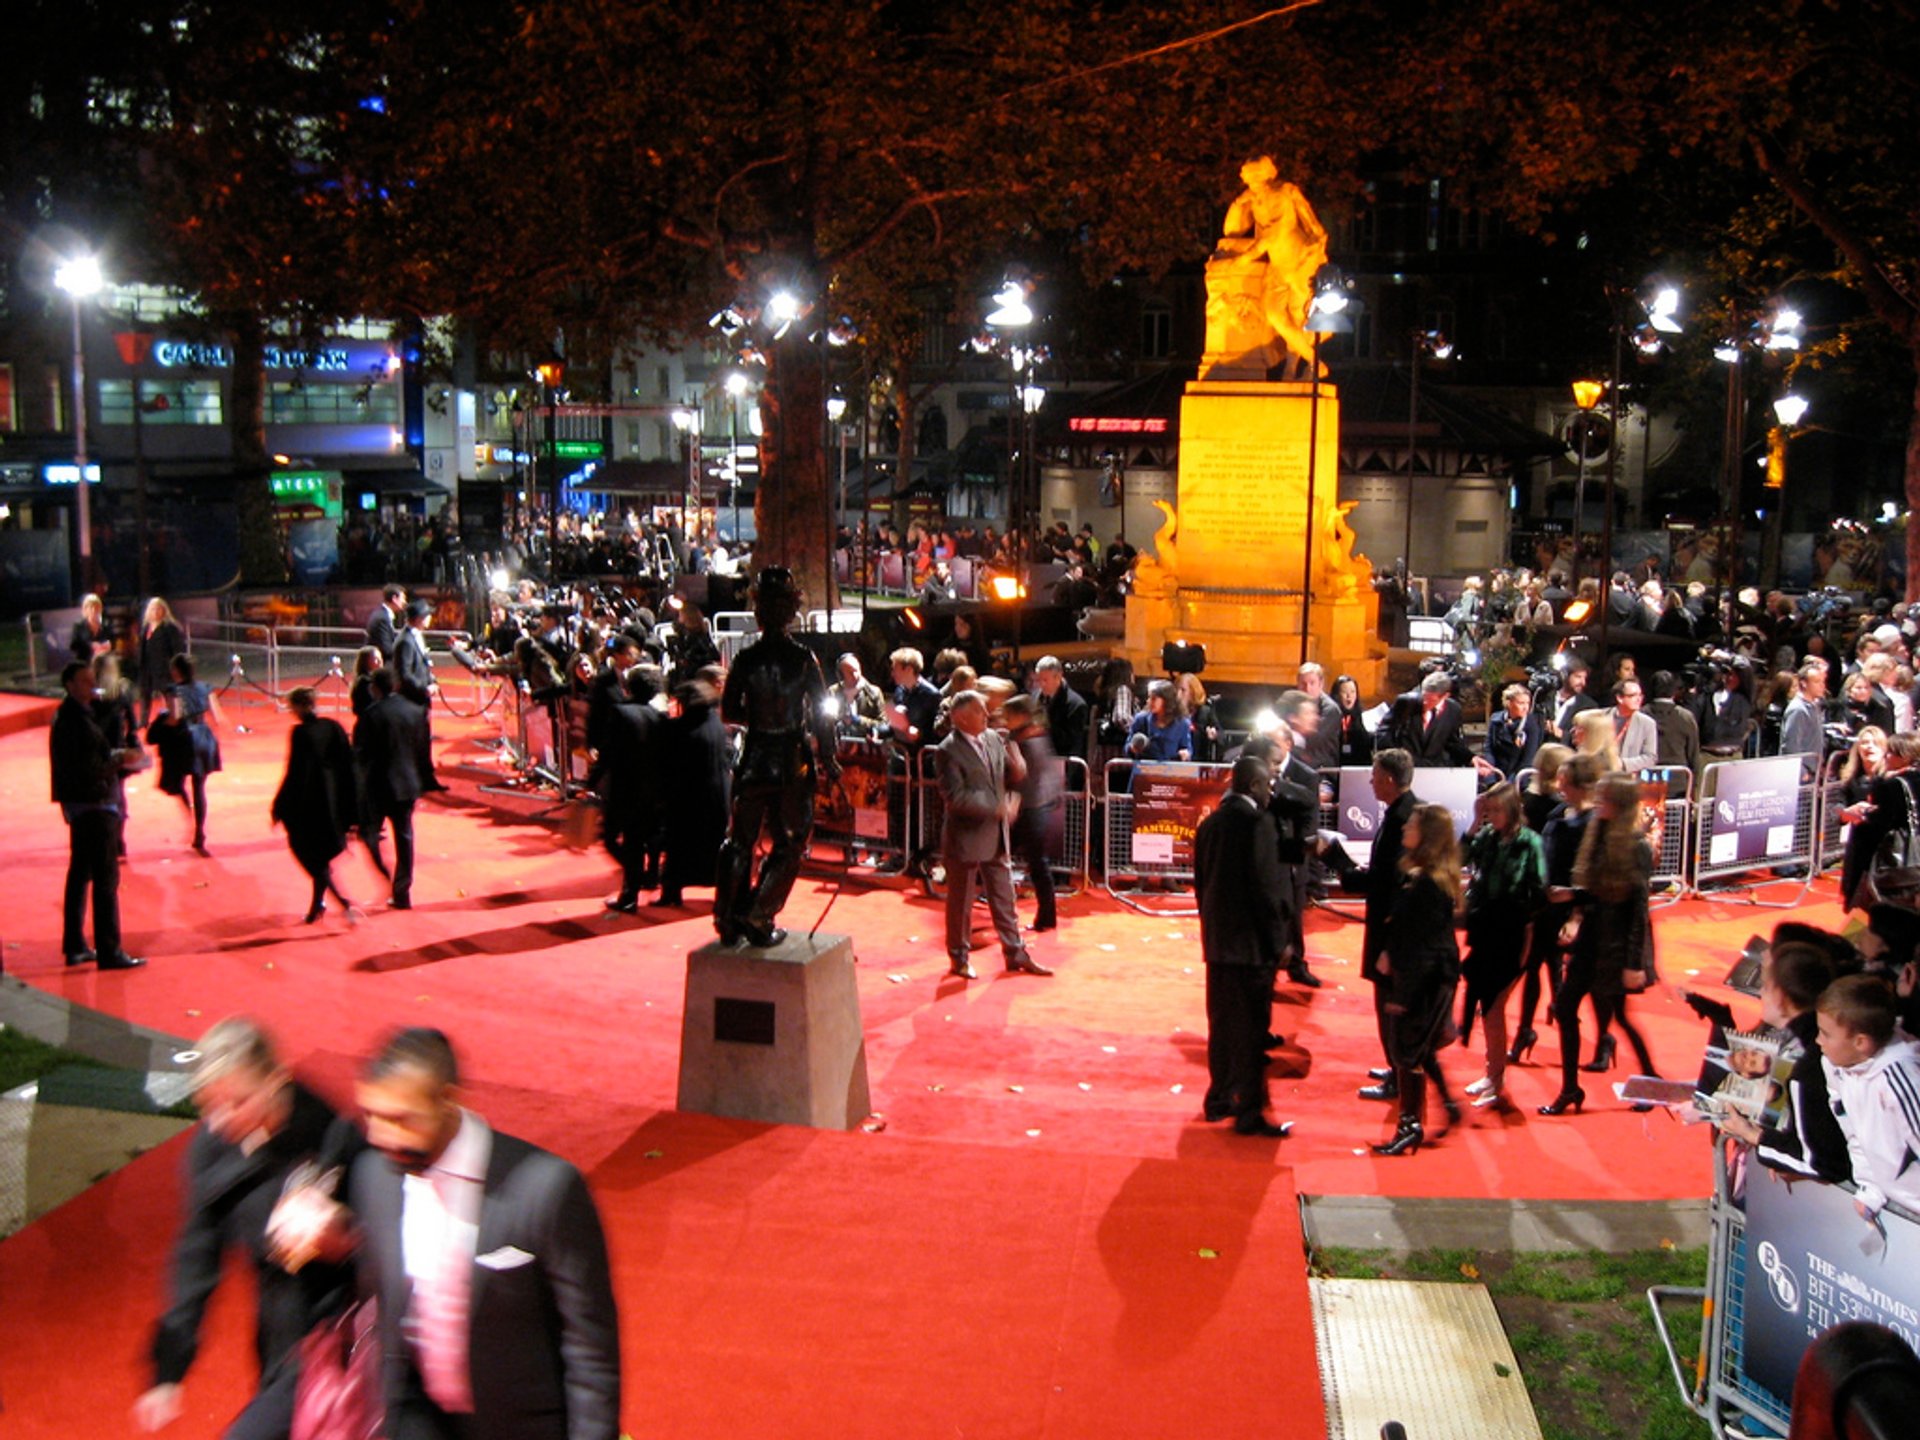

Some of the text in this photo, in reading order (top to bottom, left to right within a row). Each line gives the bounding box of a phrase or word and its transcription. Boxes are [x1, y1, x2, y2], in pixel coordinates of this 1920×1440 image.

[1806, 1252, 1919, 1326] THE TIMES
[1807, 1273, 1834, 1307] BFI
